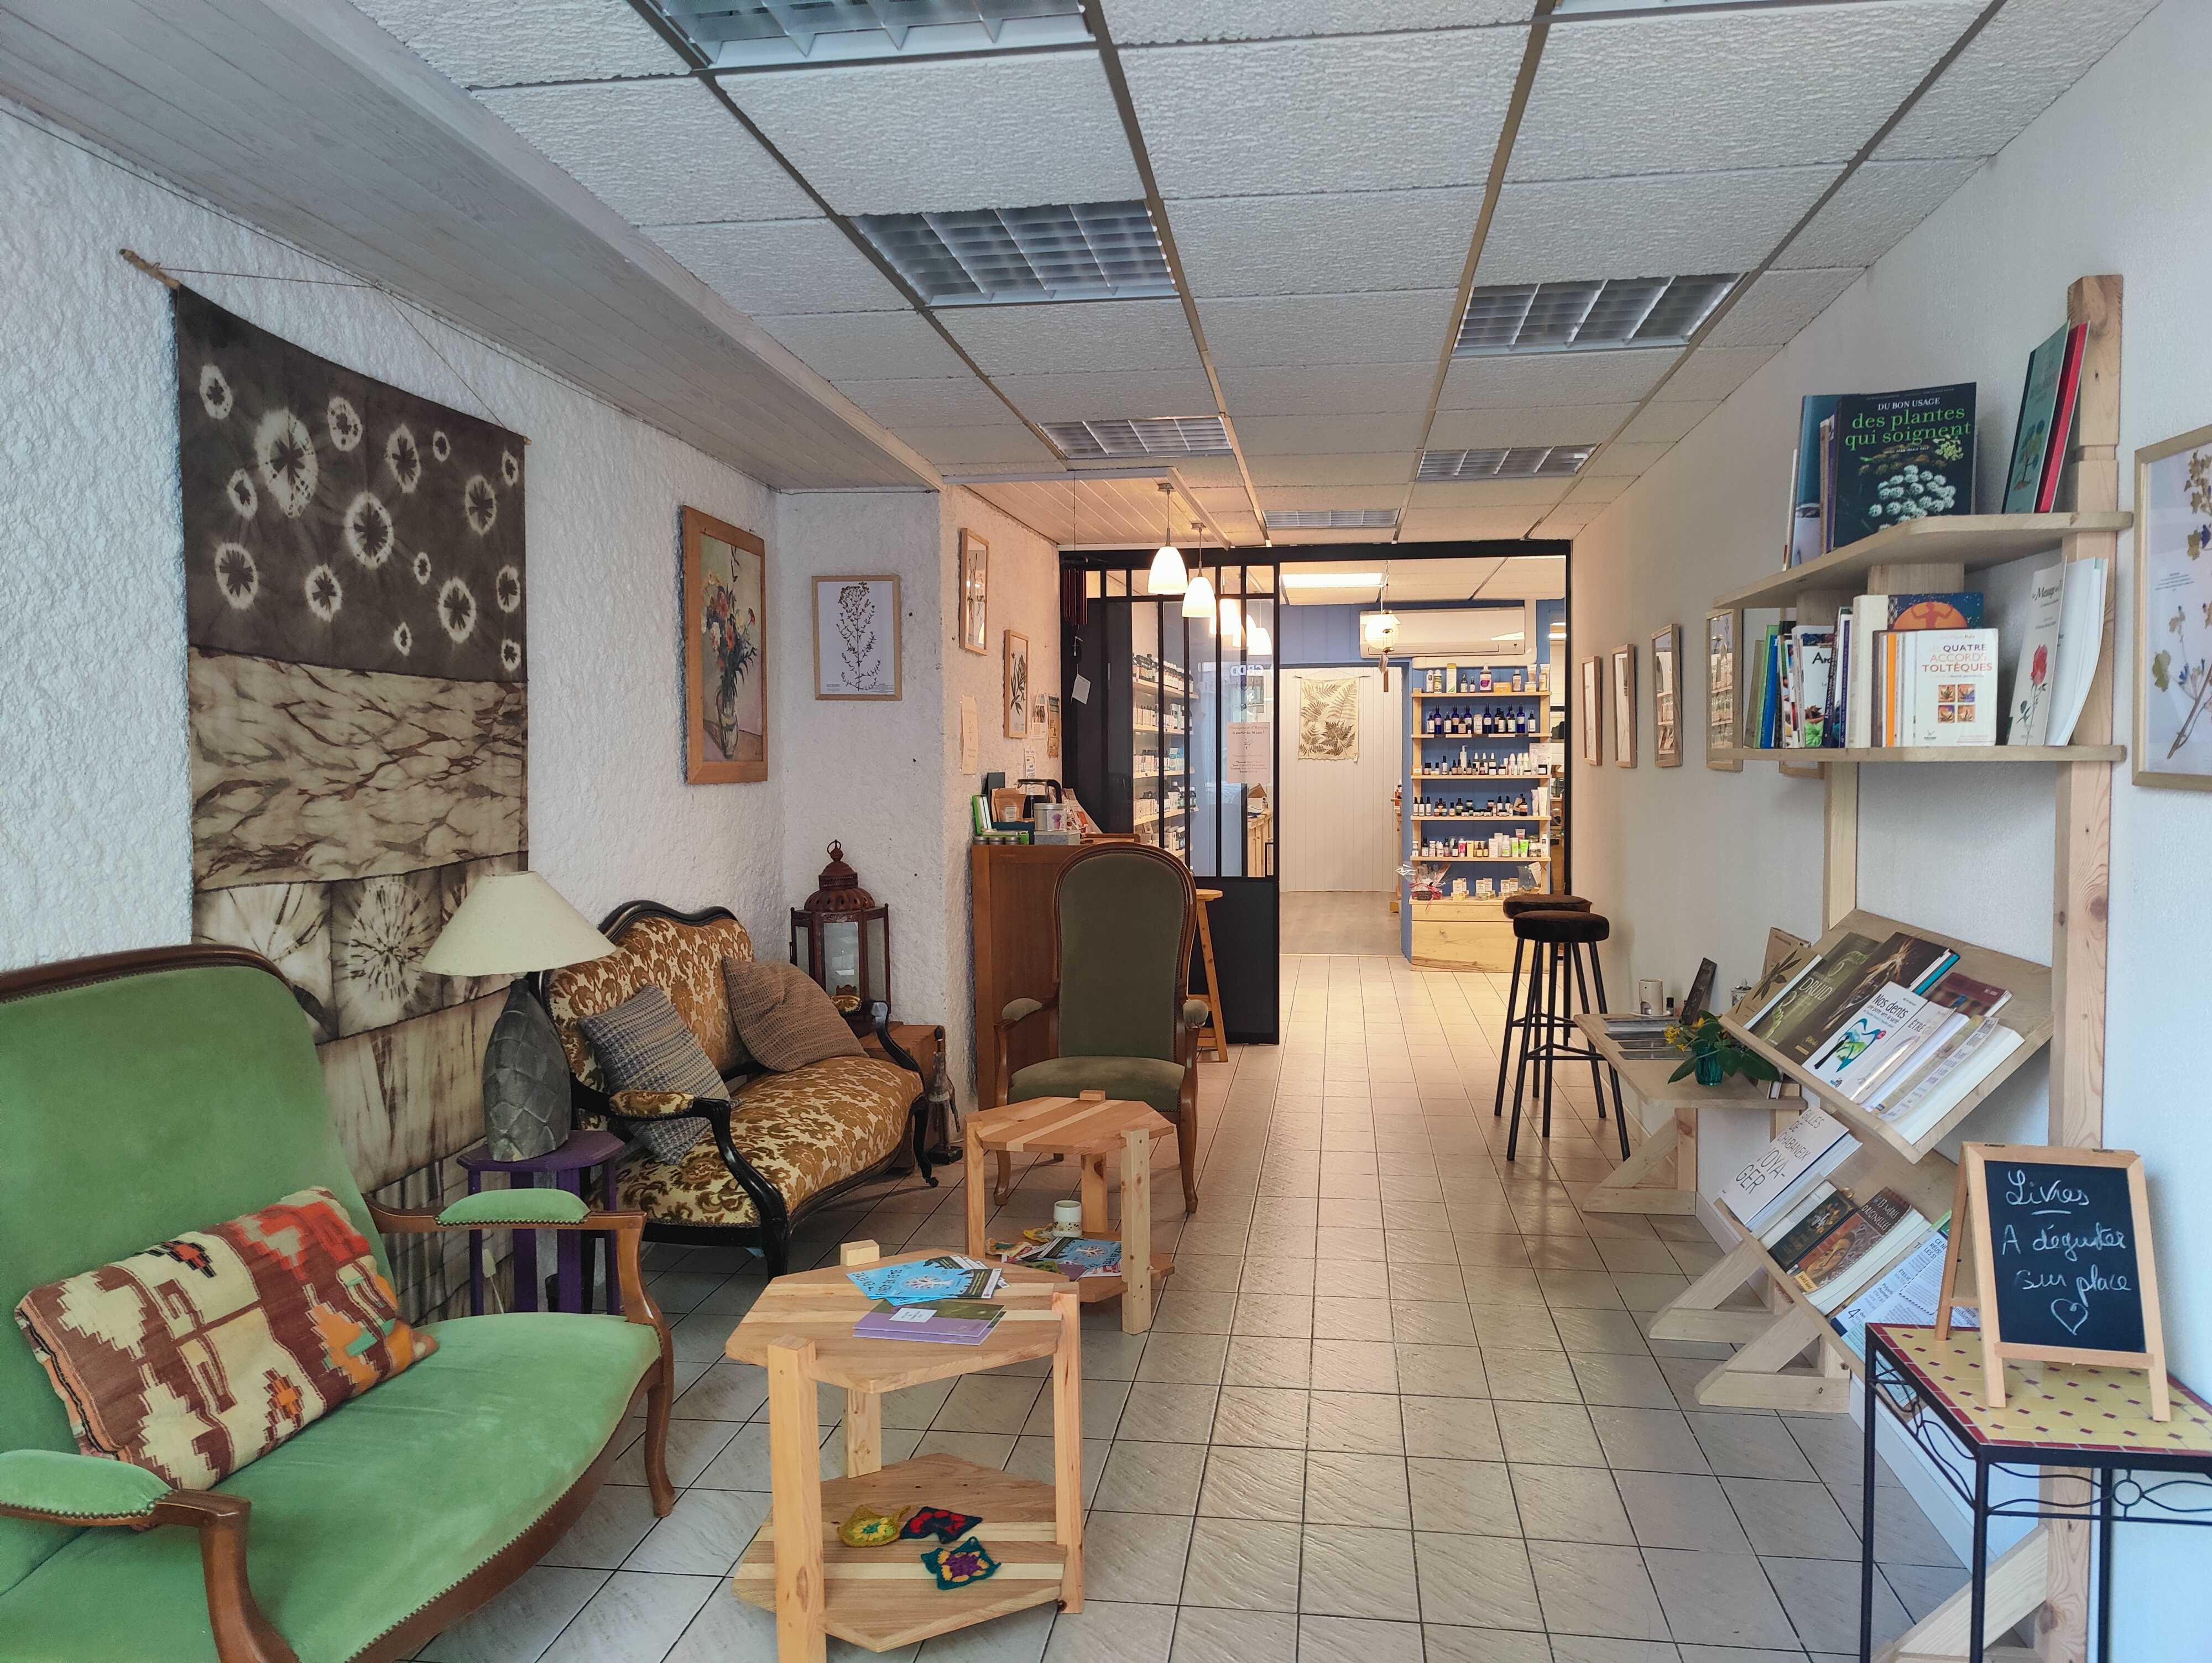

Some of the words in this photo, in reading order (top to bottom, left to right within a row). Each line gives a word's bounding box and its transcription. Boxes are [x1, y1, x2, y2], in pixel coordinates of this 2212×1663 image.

[1892, 400, 1910, 410] BON
[1912, 398, 1940, 407] USAGE
[1853, 413, 1885, 430] des
[1891, 407, 1965, 431] plantes
[1845, 429, 1877, 451] qui
[1882, 421, 1971, 444] soignent
[1930, 653, 1987, 662] ACCORDS
[1943, 644, 1987, 652] QUATRE
[1922, 662, 1992, 672] TOLTÈQUES
[1871, 993, 1889, 1008] Nos
[1885, 1001, 1909, 1019] dents
[1788, 1120, 1803, 1133] DE
[1801, 1109, 1825, 1128] GILLES
[1777, 1132, 1811, 1162] CHABANEIX
[1735, 1164, 1766, 1195] GER
[2005, 1169, 2089, 1206] Livres
[2002, 1224, 2021, 1256] A
[2032, 1222, 2126, 1262] déguster
[2076, 1264, 2132, 1308] place
[1848, 1308, 1861, 1319] 4
